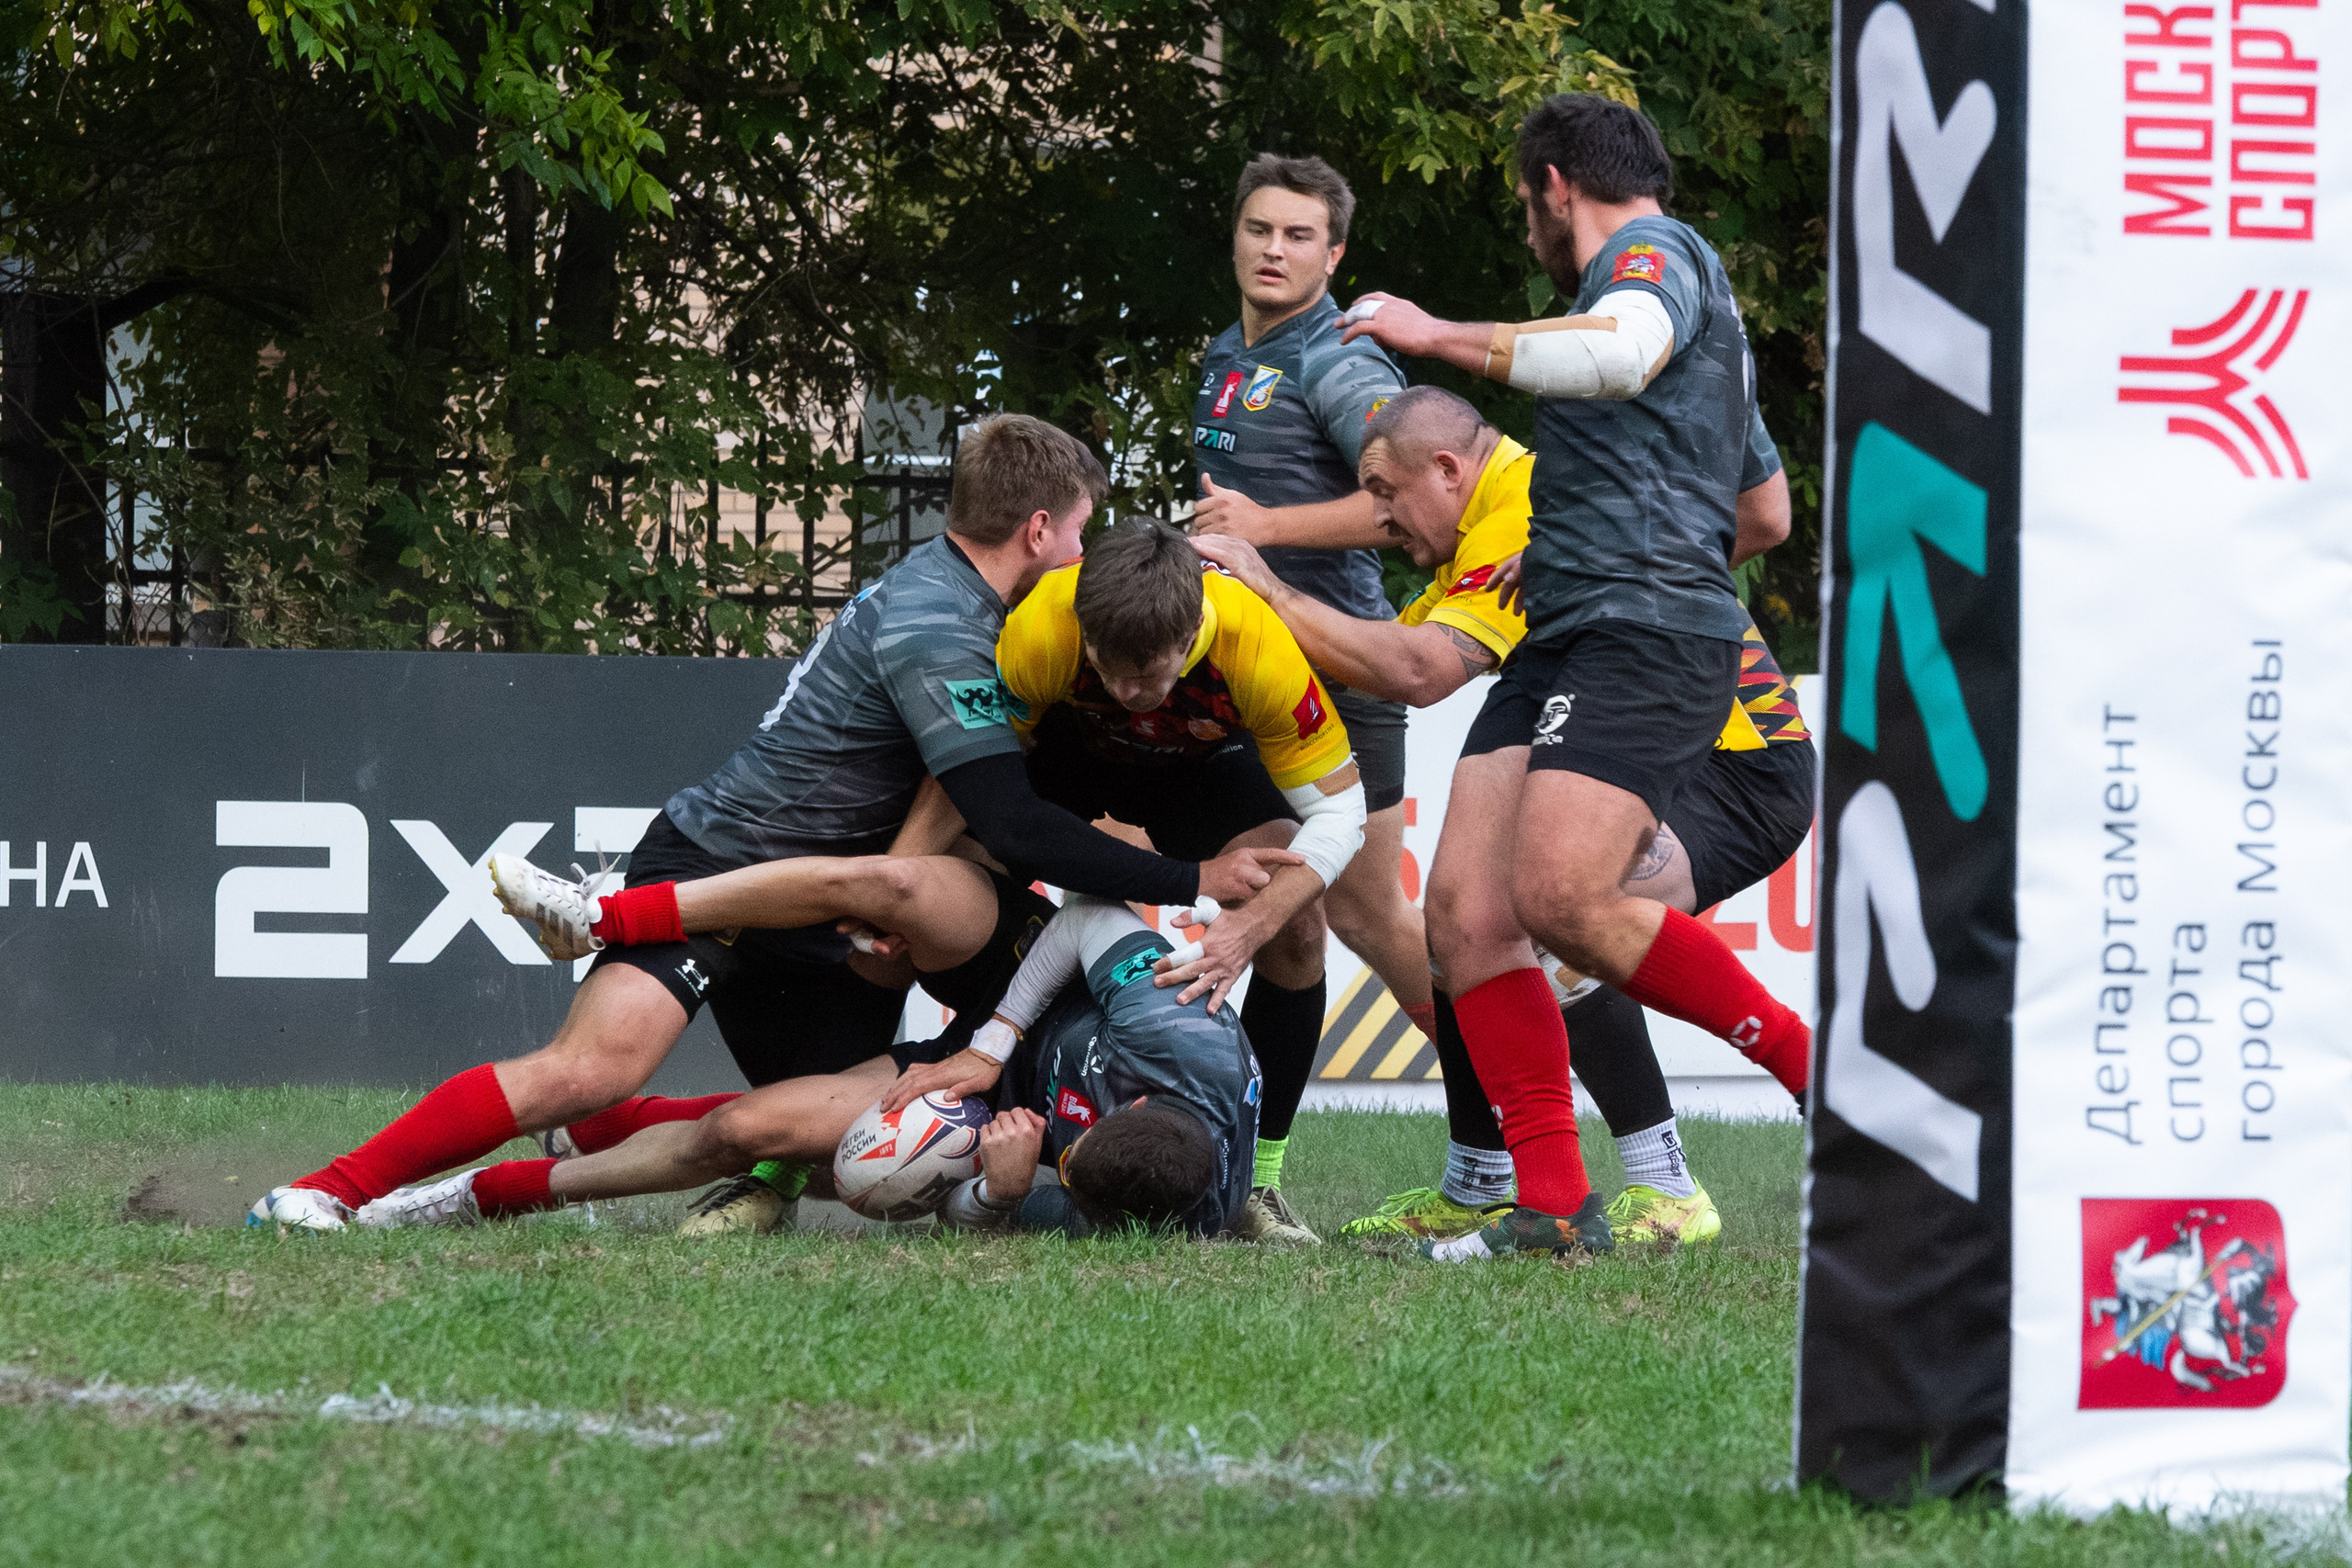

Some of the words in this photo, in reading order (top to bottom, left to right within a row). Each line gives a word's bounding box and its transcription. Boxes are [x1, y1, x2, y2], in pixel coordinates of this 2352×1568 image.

[1194, 426, 1237, 452] PARI
[1825, 0, 1996, 1204] PAR
[2236, 640, 2284, 892] Москвы
[2086, 703, 2148, 1145] Департамент
[2166, 921, 2214, 1142] спорта
[2239, 921, 2284, 1142] города
[841, 1128, 865, 1151] РЕГБИ
[842, 1134, 876, 1165] РОССИИ
